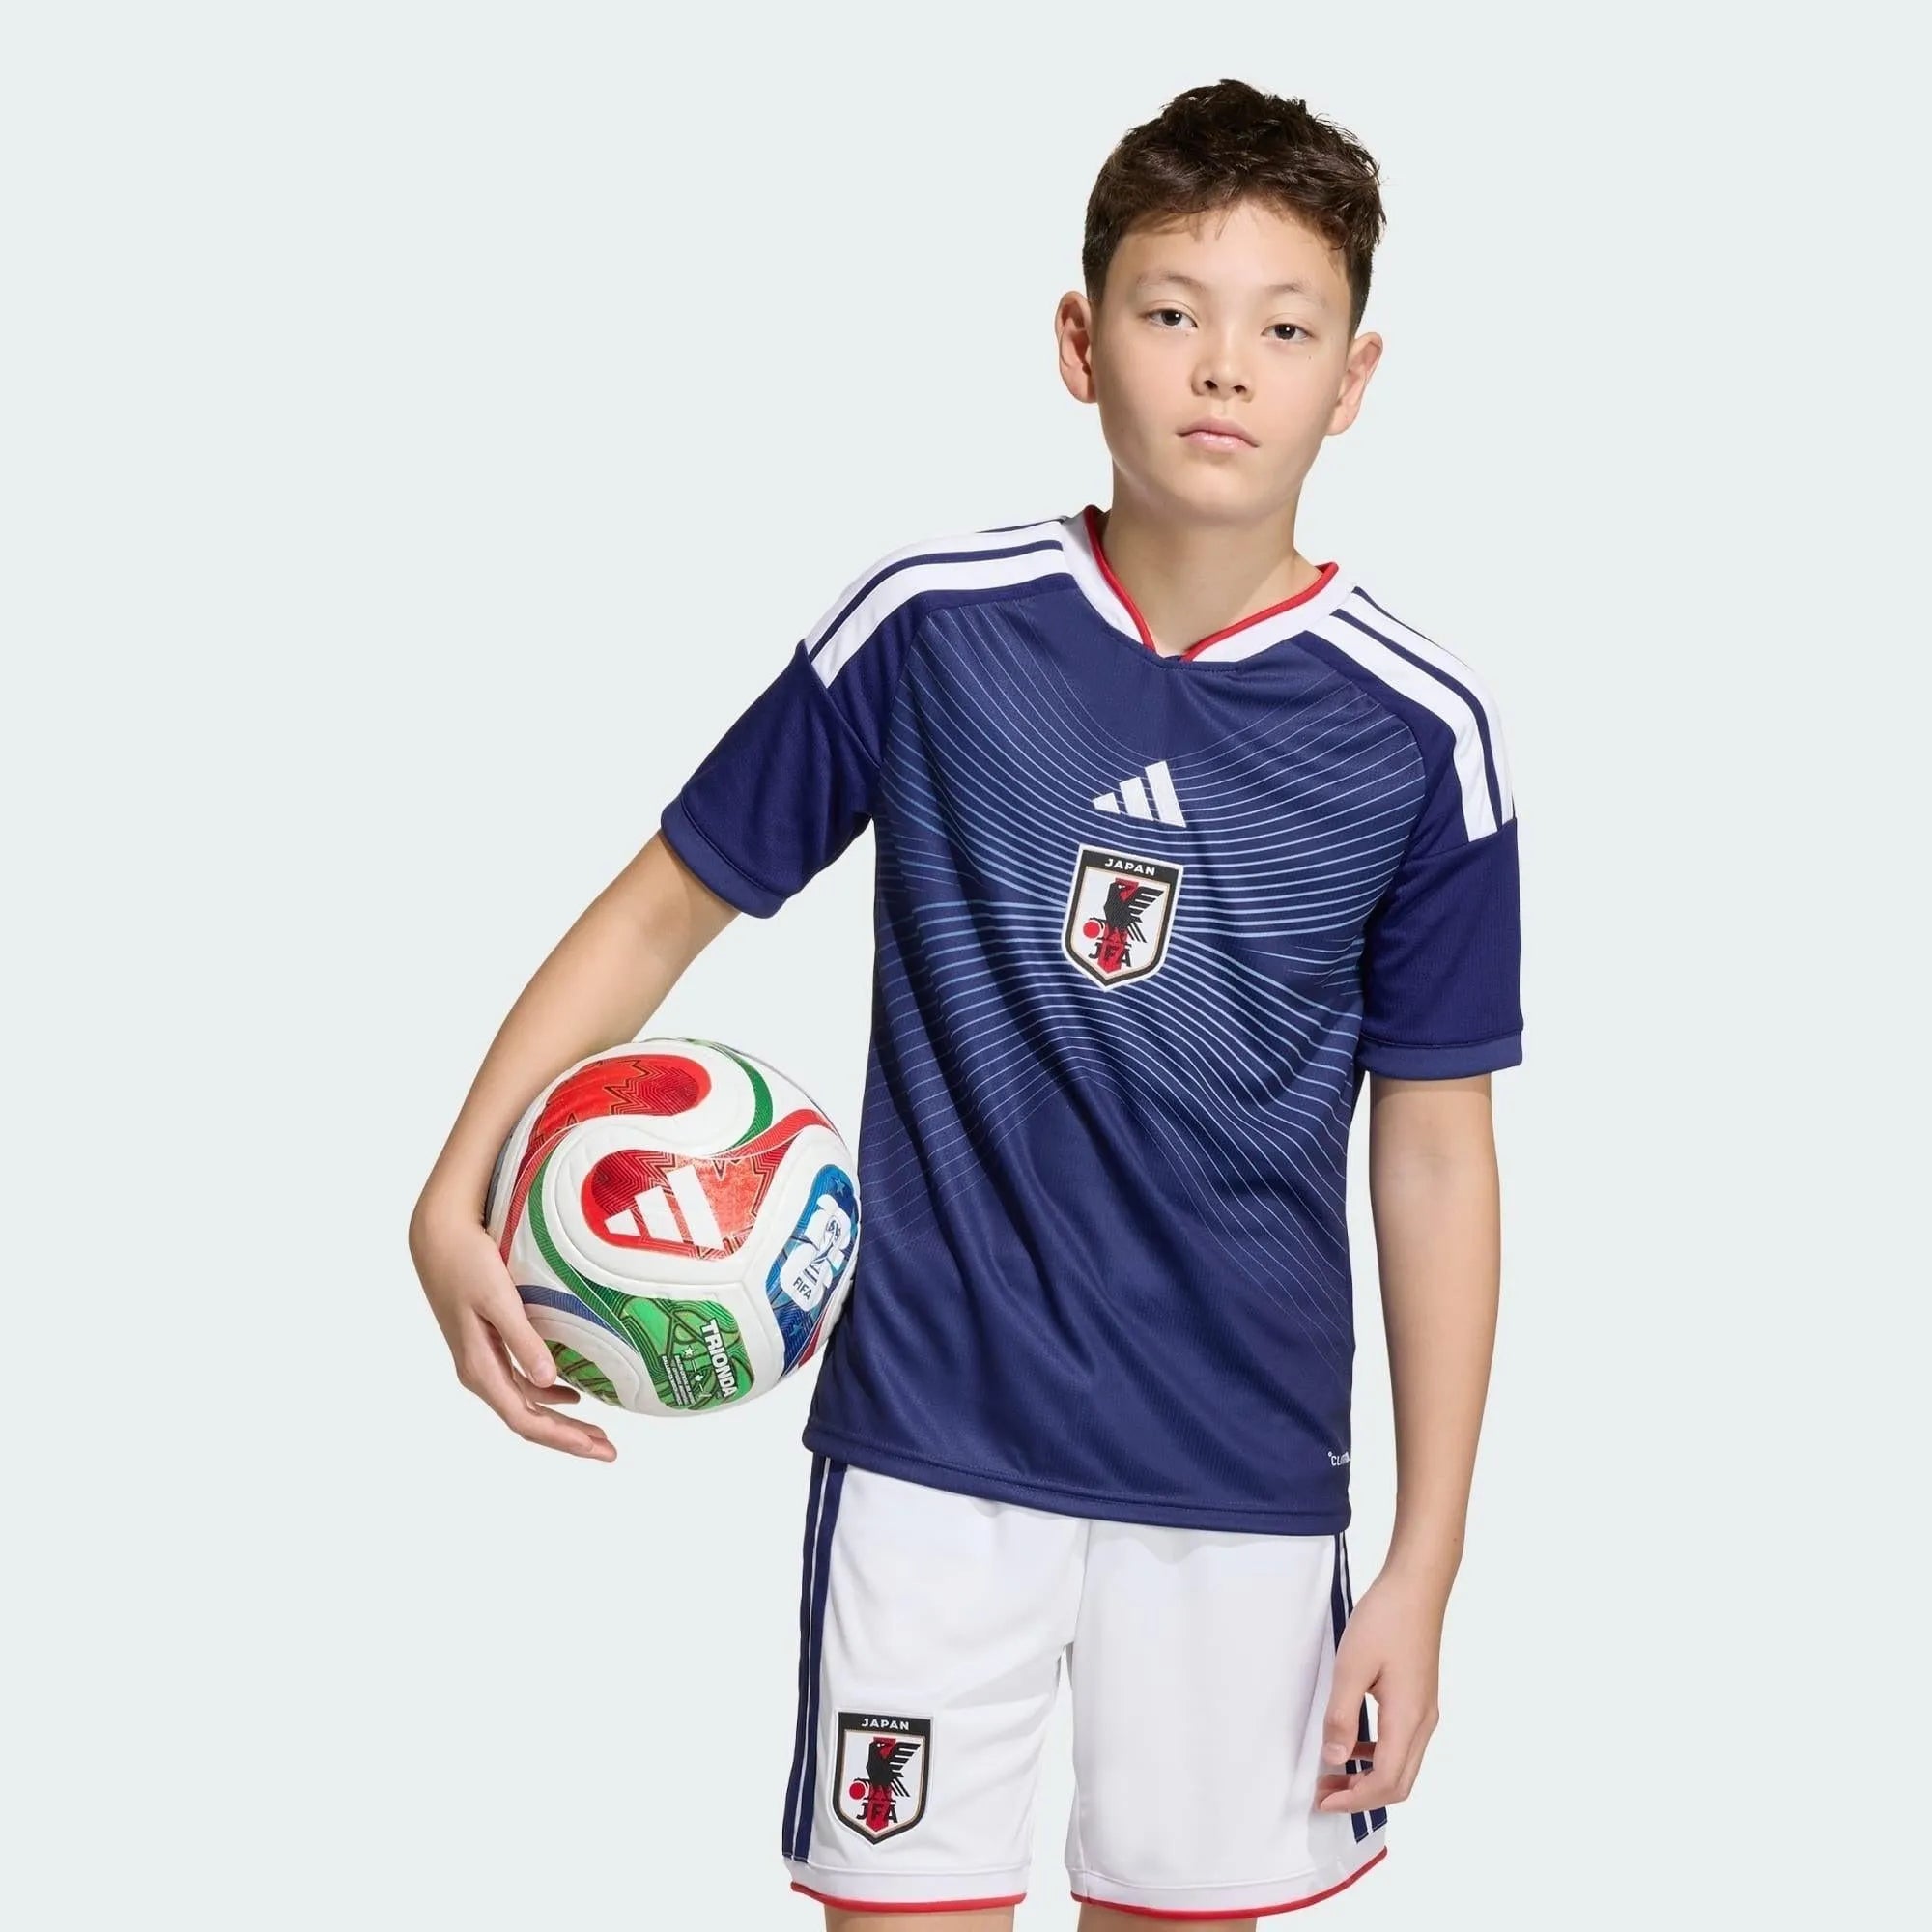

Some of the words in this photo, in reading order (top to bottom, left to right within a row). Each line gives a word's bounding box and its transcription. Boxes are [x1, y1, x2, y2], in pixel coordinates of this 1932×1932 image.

[1105, 858, 1155, 876] JAPAN
[792, 1277, 812, 1300] FIFA
[701, 1319, 738, 1397] TRIONDA
[861, 1718, 909, 1731] JAPAN
